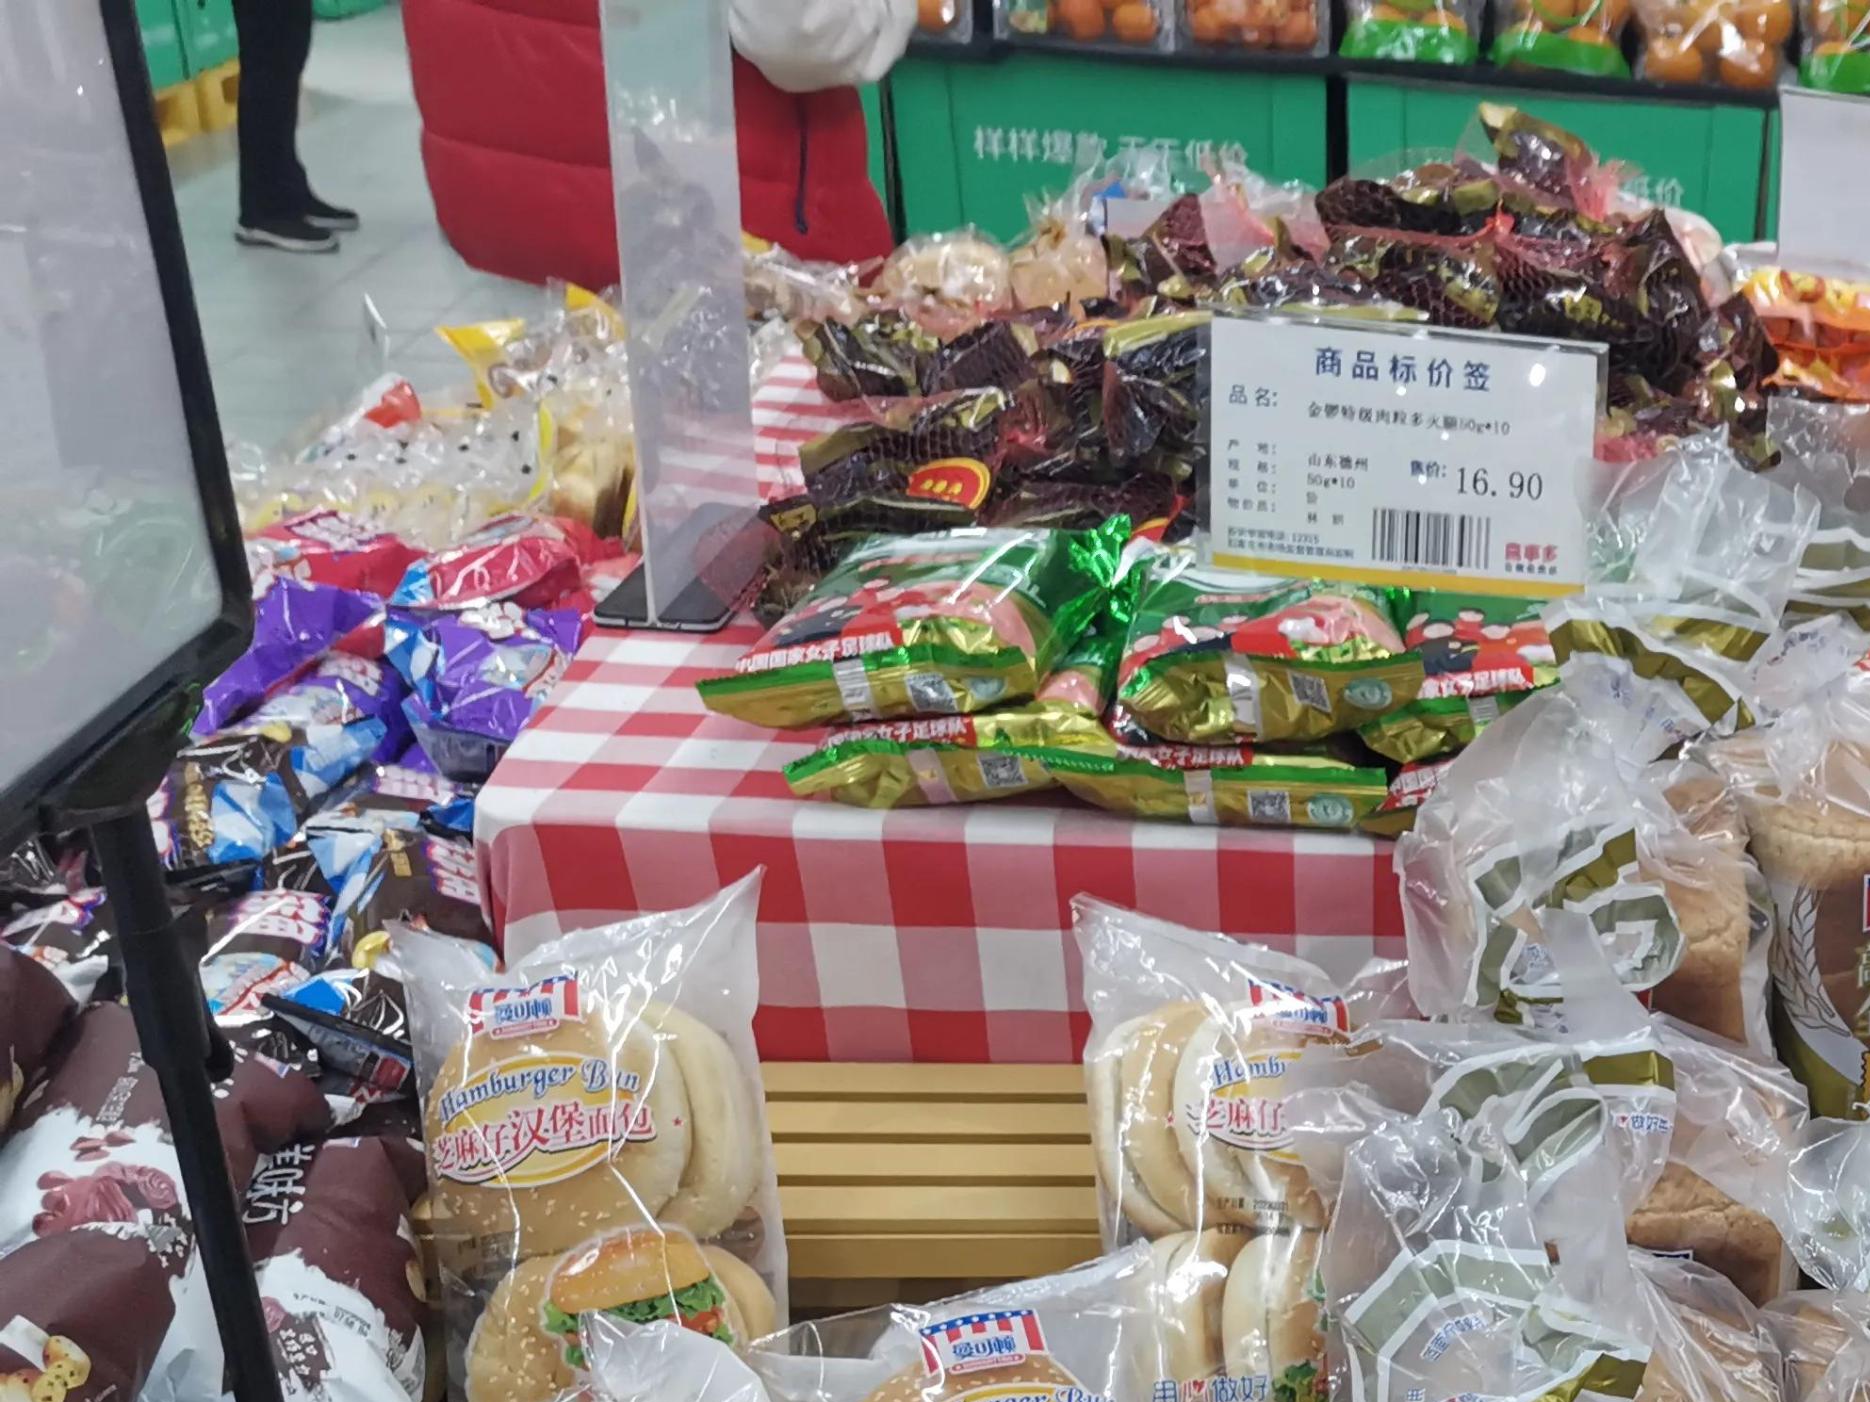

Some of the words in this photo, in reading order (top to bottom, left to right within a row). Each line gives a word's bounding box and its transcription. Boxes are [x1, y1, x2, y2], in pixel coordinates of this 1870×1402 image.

[1315, 347, 1491, 392] 商品标价签
[1228, 385, 1278, 408] 品名：
[1455, 466, 1544, 501] 16.90
